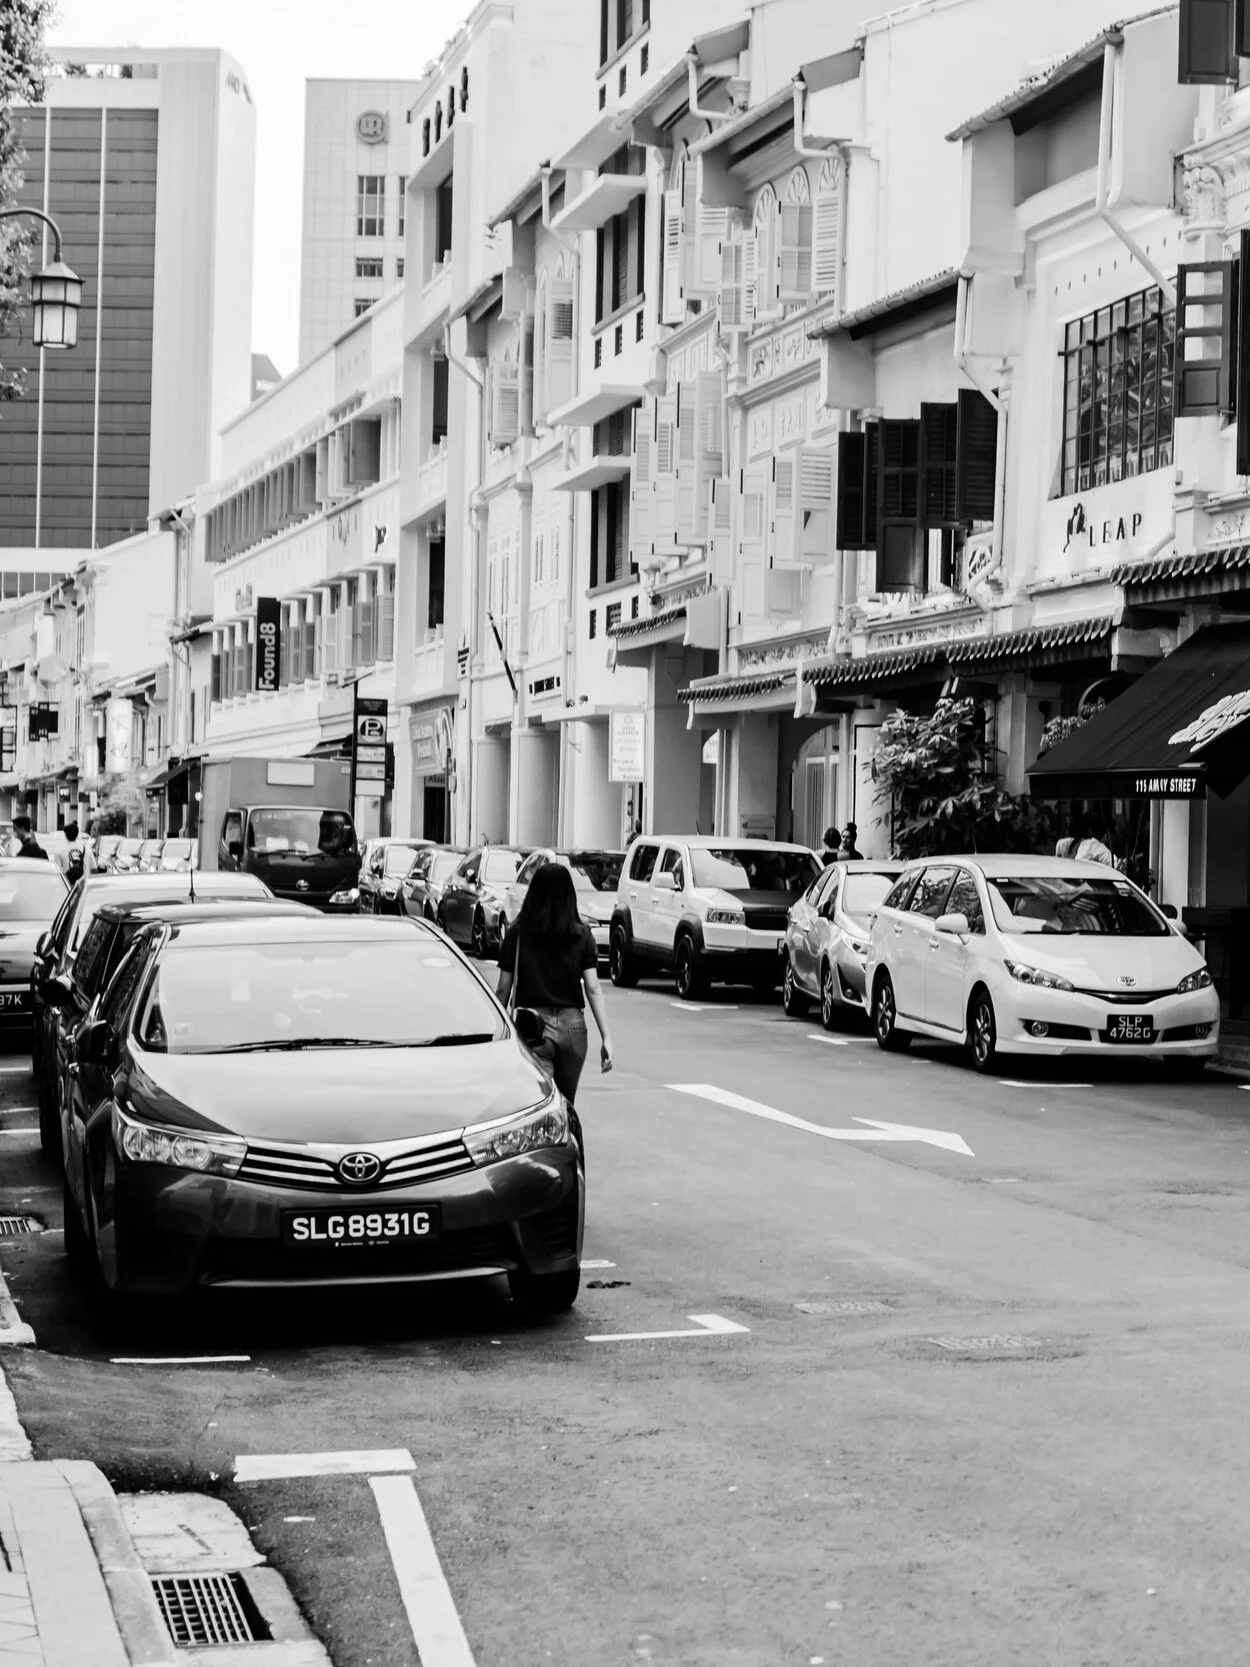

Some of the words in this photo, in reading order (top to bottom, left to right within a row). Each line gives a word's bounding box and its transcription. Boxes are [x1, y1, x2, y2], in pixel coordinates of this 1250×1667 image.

[1089, 513, 1142, 547] LEAP
[258, 622, 276, 690] Found8
[1170, 777, 1197, 793] STREET
[1110, 1027, 1151, 1038] 4762G
[1119, 1016, 1142, 1027] SLP
[292, 1212, 430, 1241] SLG8931G
